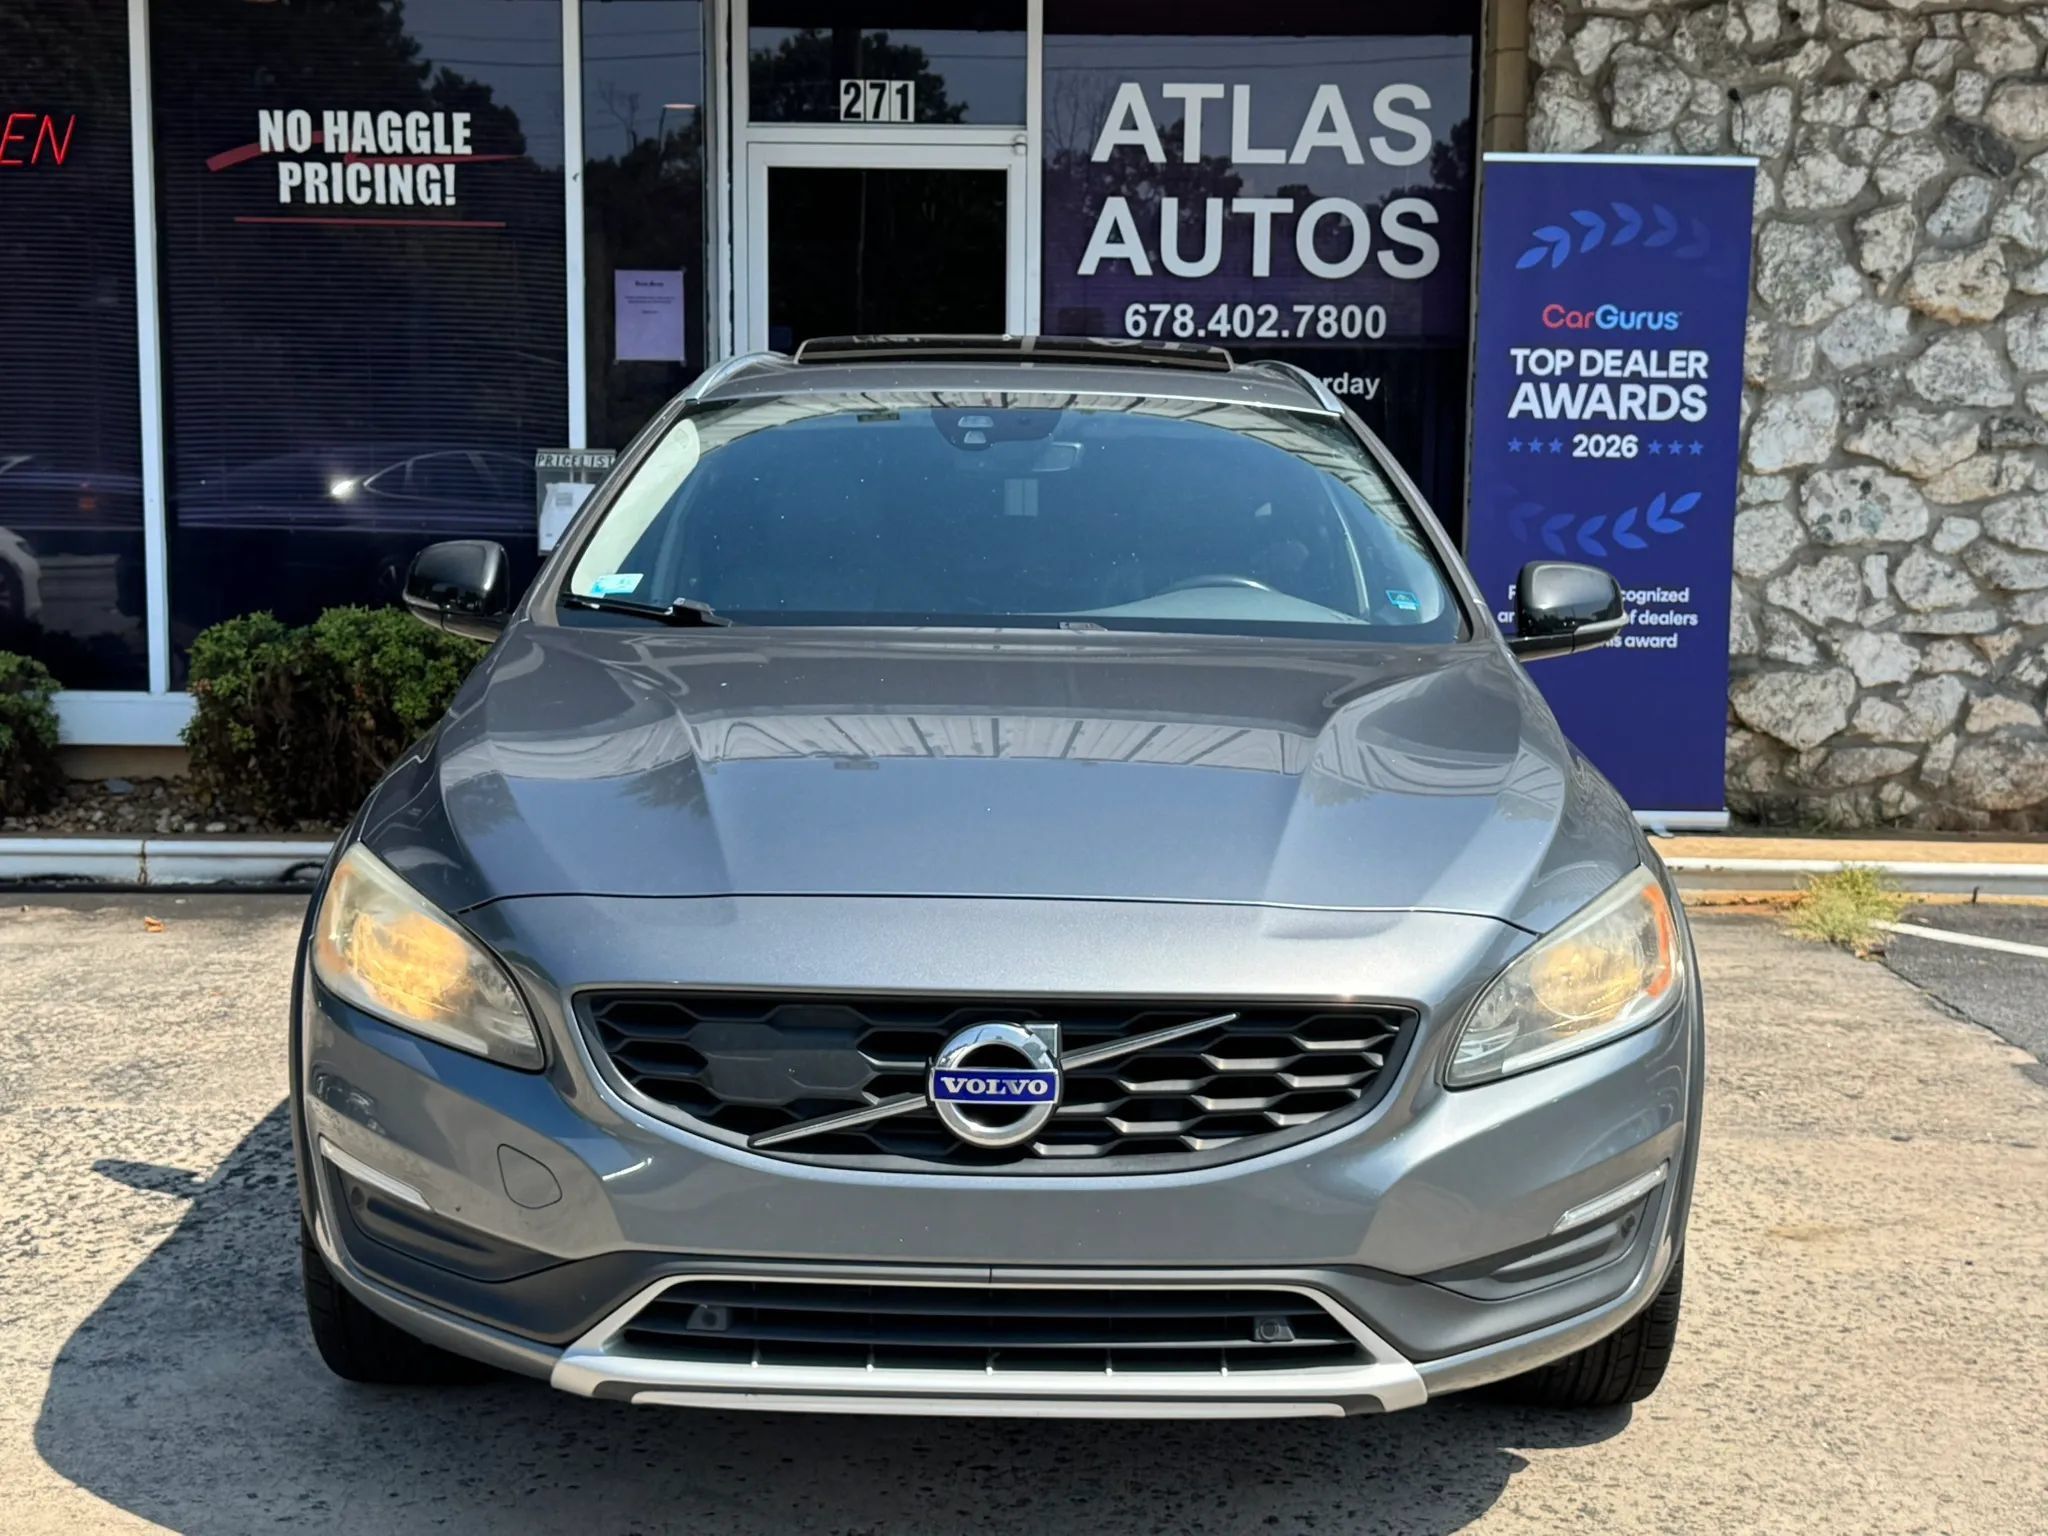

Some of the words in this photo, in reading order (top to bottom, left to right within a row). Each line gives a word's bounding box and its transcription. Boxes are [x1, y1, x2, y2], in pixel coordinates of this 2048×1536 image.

[843, 81, 909, 120] 271
[258, 109, 313, 153] NO
[323, 110, 473, 155] HAGGLE
[1090, 82, 1433, 166] ATLAS
[278, 161, 456, 206] PRICING!
[1076, 196, 1441, 280] AUTOS
[1124, 303, 1388, 340] 678.402.7800
[1542, 303, 1680, 331] CarGurus
[1510, 348, 1575, 376] TOP
[1579, 349, 1709, 379] DEALER
[1318, 371, 1381, 401] rday
[1507, 382, 1708, 422] AWARDS
[1572, 433, 1639, 459] 2026
[1638, 609, 1699, 626] dealers
[1624, 632, 1679, 649] award
[940, 1076, 1049, 1096] VOLVO
